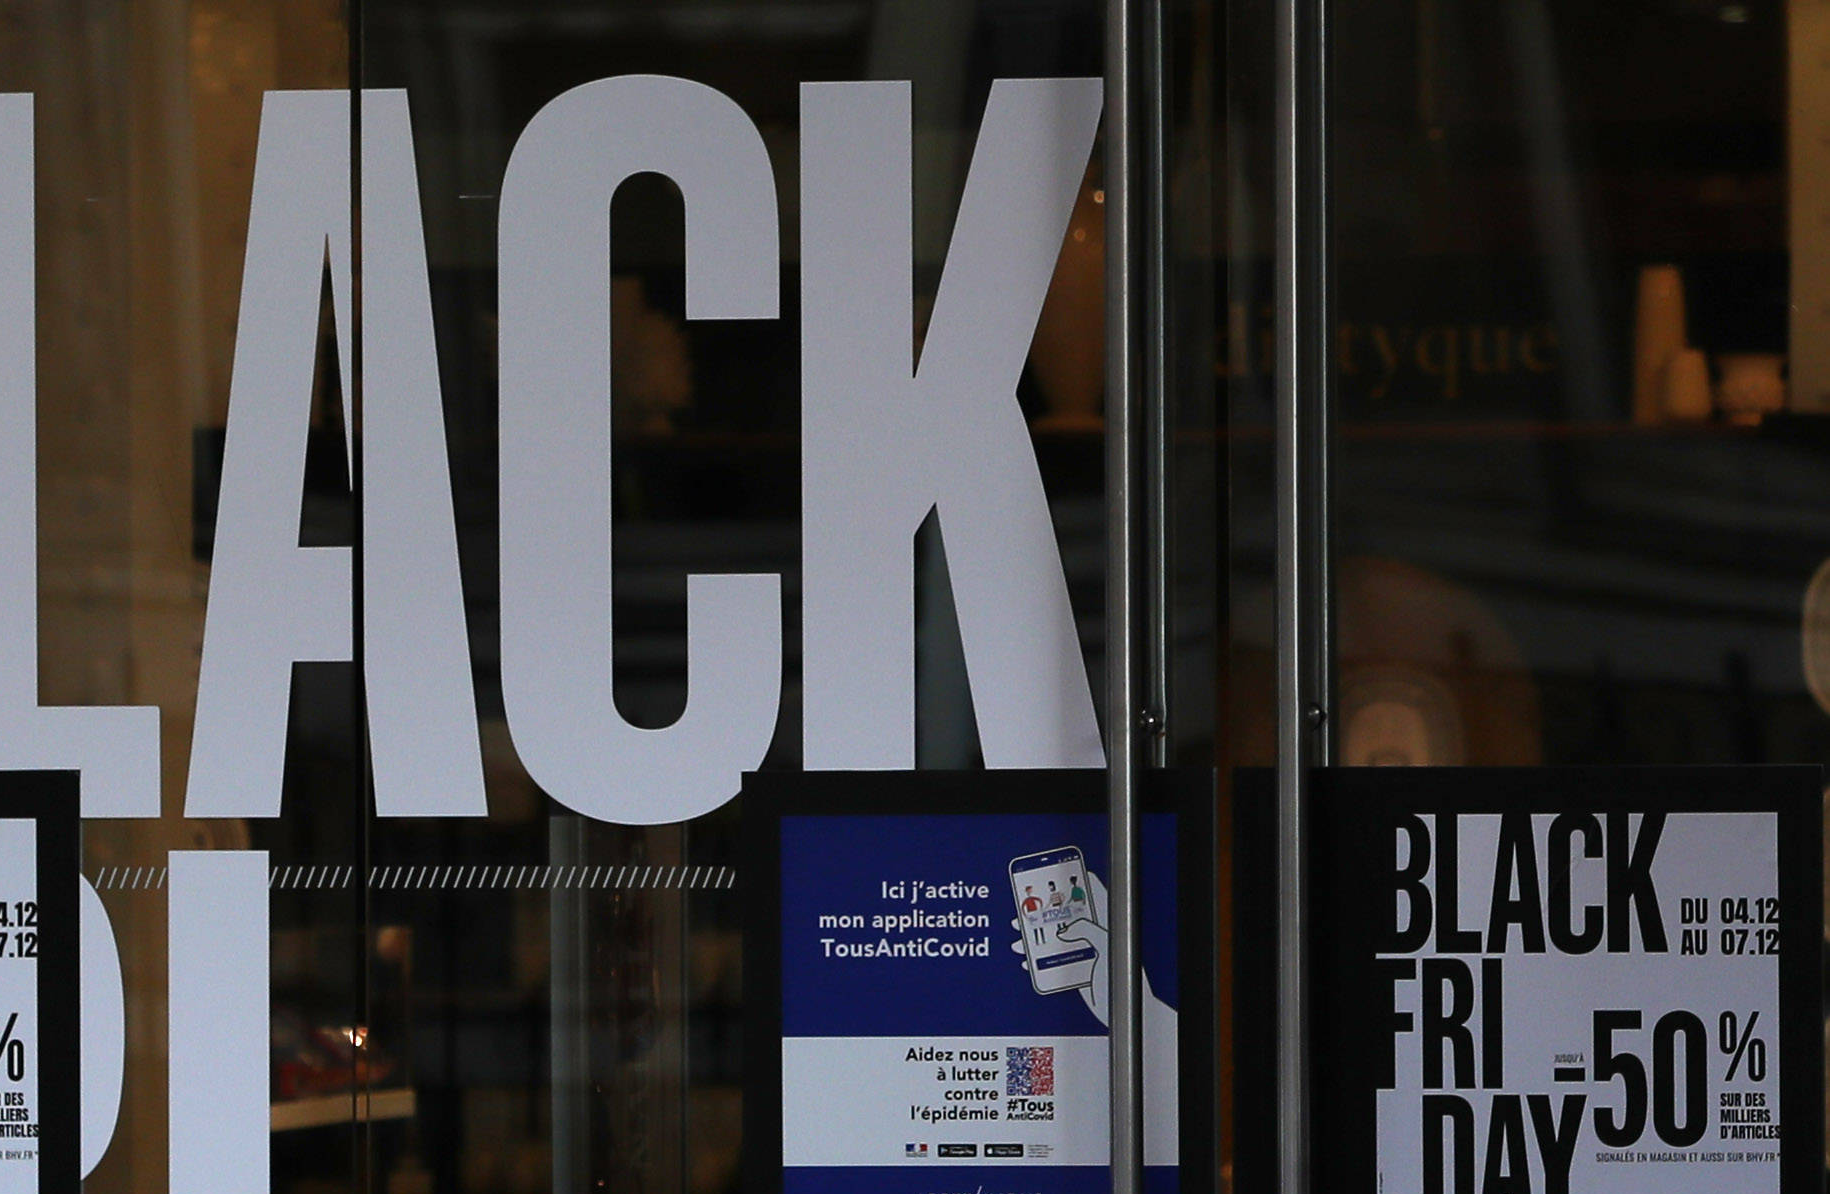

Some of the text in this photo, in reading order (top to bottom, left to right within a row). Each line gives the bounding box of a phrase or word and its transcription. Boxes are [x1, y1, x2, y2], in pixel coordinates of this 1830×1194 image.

[882, 880, 905, 899] Ici
[1375, 811, 1669, 955] BLACK
[1681, 897, 1781, 925] DU 04.12
[818, 909, 990, 934] mon application
[820, 936, 990, 958] TousAntiCovid
[1680, 928, 1781, 956] AU 07.12
[1375, 958, 1503, 1089] FRI
[905, 1047, 999, 1062] Aidez nous
[936, 1066, 999, 1082] à lutter
[8, 1092, 25, 1107] DES
[944, 1087, 999, 1101] contre
[1719, 1093, 1766, 1107] SUR DES
[1007, 1099, 1054, 1112] #Tous
[1006, 1111, 1054, 1121] AntiCovid
[1719, 1109, 1771, 1123] MILLIERS
[1596, 1151, 1635, 1162] SIGNALÉS
[1637, 1152, 1648, 1162] EN
[1650, 1152, 1687, 1162] MAGASIN
[1689, 1152, 1699, 1162] ET
[1700, 1152, 1725, 1162] AUSSI
[1727, 1152, 1744, 1162] SUR
